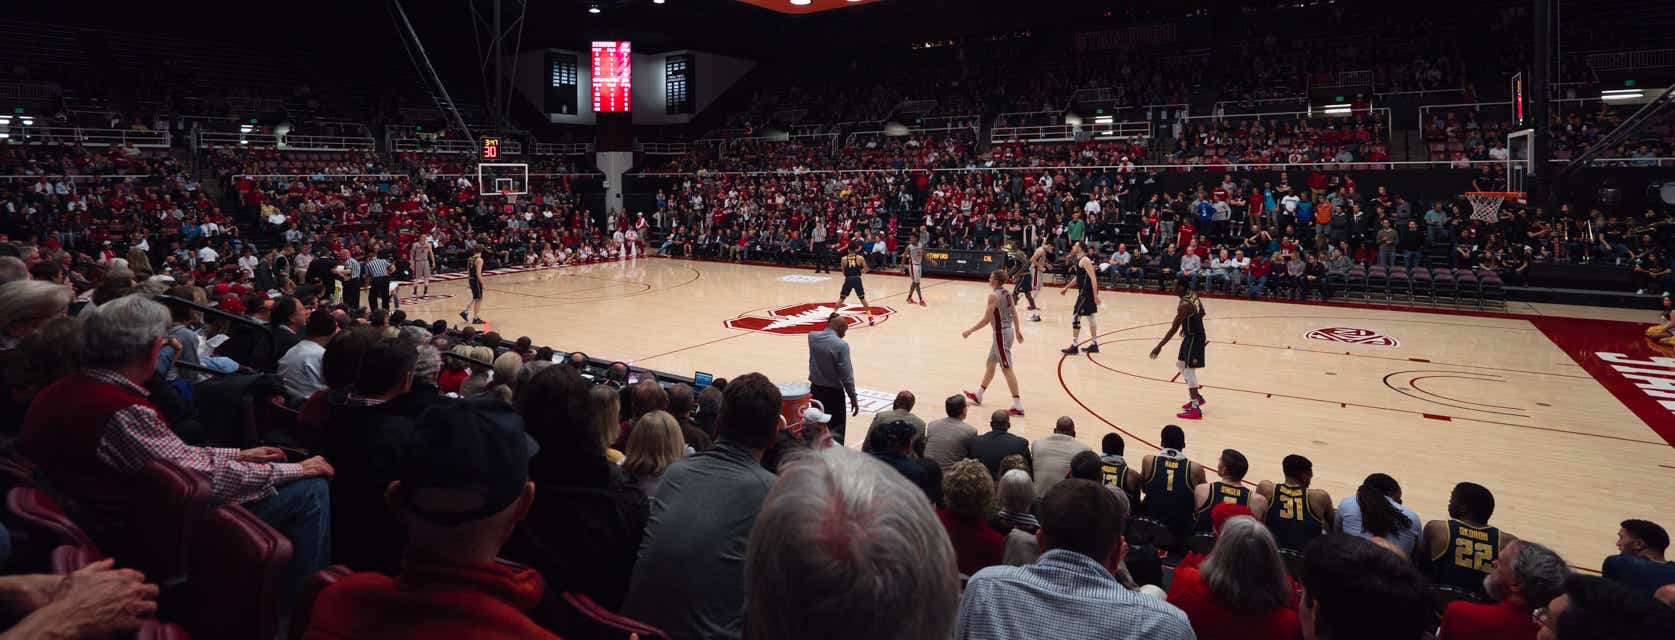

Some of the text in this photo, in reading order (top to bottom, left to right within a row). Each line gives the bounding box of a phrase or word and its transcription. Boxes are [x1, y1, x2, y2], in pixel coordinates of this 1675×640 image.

[484, 146, 497, 158] 30
[1166, 469, 1174, 491] 1
[1279, 494, 1304, 520] 31
[1455, 537, 1493, 573] 22
